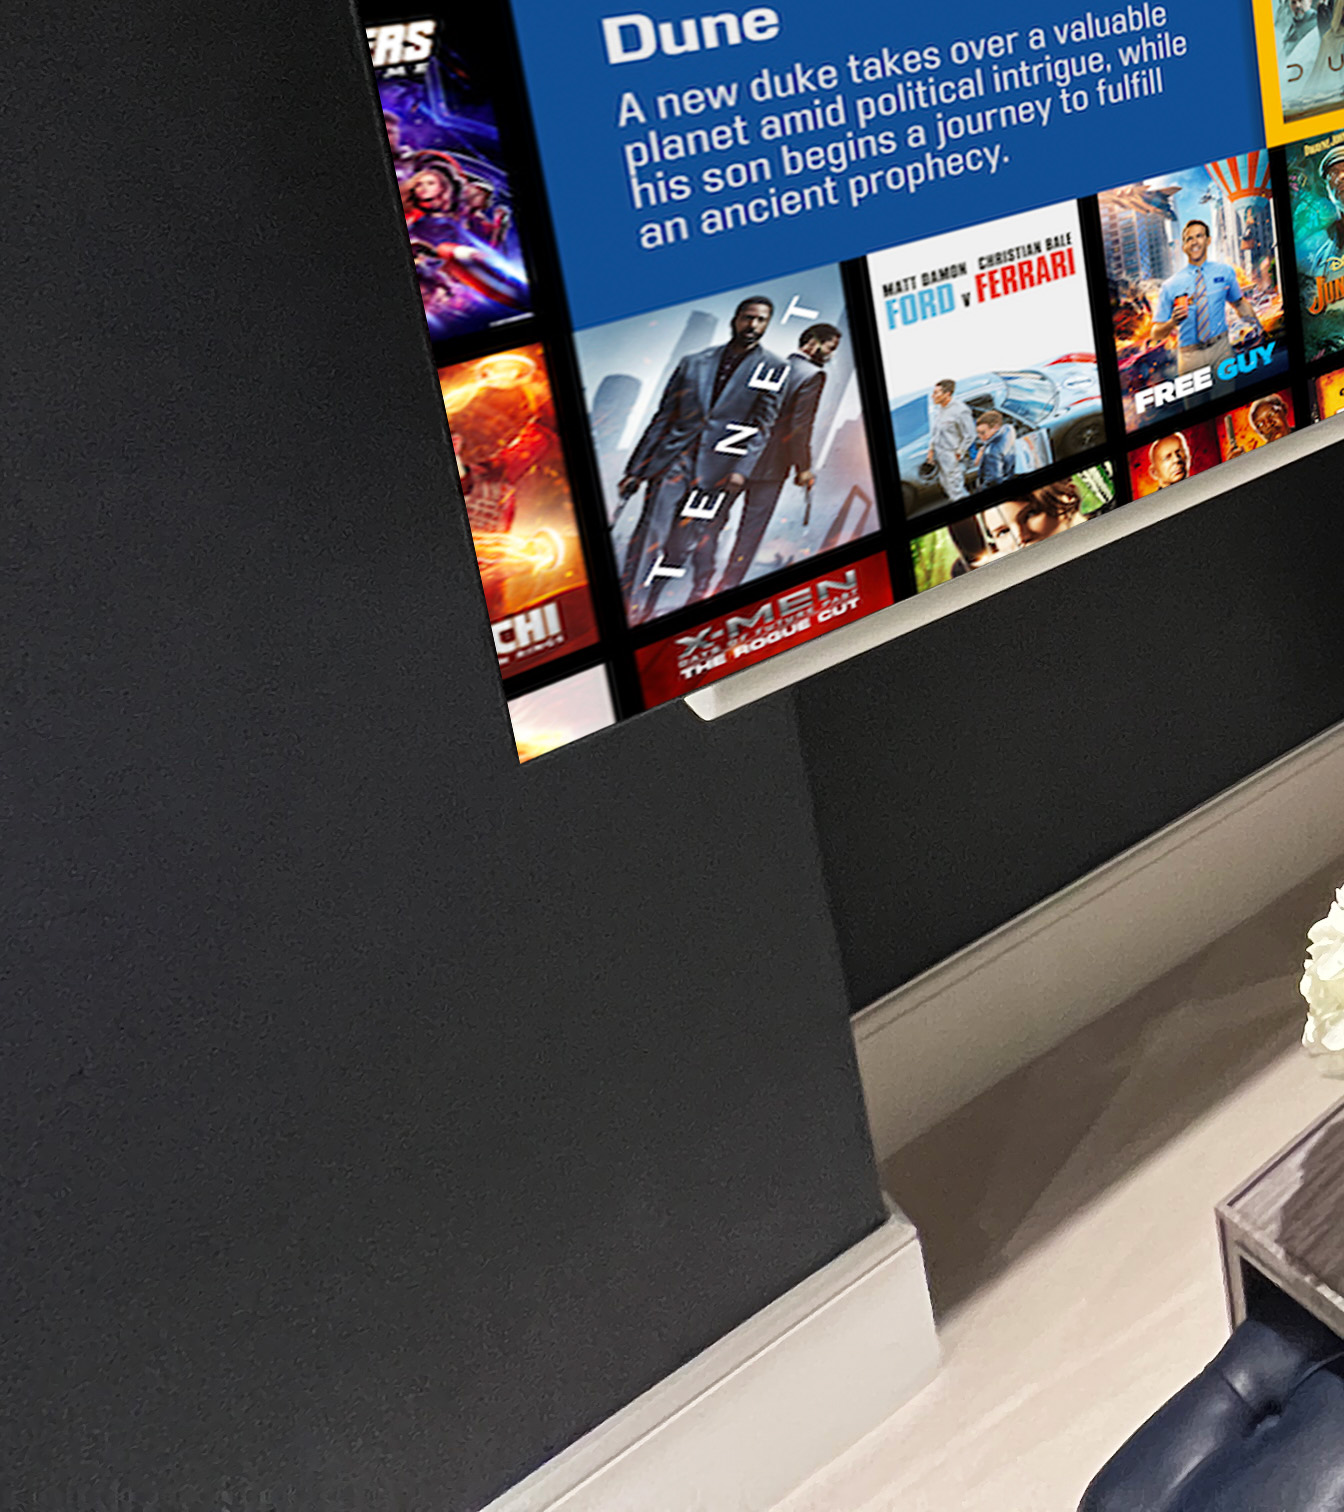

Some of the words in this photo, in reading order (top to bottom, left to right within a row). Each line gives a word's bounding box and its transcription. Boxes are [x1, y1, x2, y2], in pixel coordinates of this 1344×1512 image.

[602, 7, 780, 64] Dune
[618, 92, 646, 127] A
[657, 83, 738, 119] new
[750, 63, 838, 101] duke
[848, 46, 941, 83] takes
[950, 31, 1019, 65] over
[1028, 27, 1046, 50] a
[1053, 2, 1167, 45] valuable
[625, 116, 749, 176] planet
[760, 95, 846, 140] amid
[857, 68, 984, 128] political
[993, 51, 1111, 92] intrigue,
[1118, 32, 1187, 66] while
[630, 171, 691, 209] his
[702, 158, 771, 192] son
[781, 131, 896, 176] begins
[907, 125, 926, 149] a
[936, 97, 1051, 150] journey
[1060, 88, 1088, 113] to
[1096, 67, 1163, 105] fulfill
[640, 216, 689, 249] an
[701, 176, 839, 235] ancient
[850, 144, 1010, 207] prophecy.
[883, 275, 917, 298] MATT
[921, 262, 968, 286] DAMON
[885, 283, 956, 330] FORD
[975, 247, 1076, 304] FERRARI
[978, 241, 1042, 271] CHRISTIAN
[1046, 232, 1072, 251] BALE
[1134, 365, 1214, 415] FREE
[1216, 340, 1276, 381] GUY
[674, 568, 857, 659] X-MEN
[679, 651, 727, 680] THE
[732, 618, 811, 658] ROGUE
[817, 597, 861, 623] CUT
